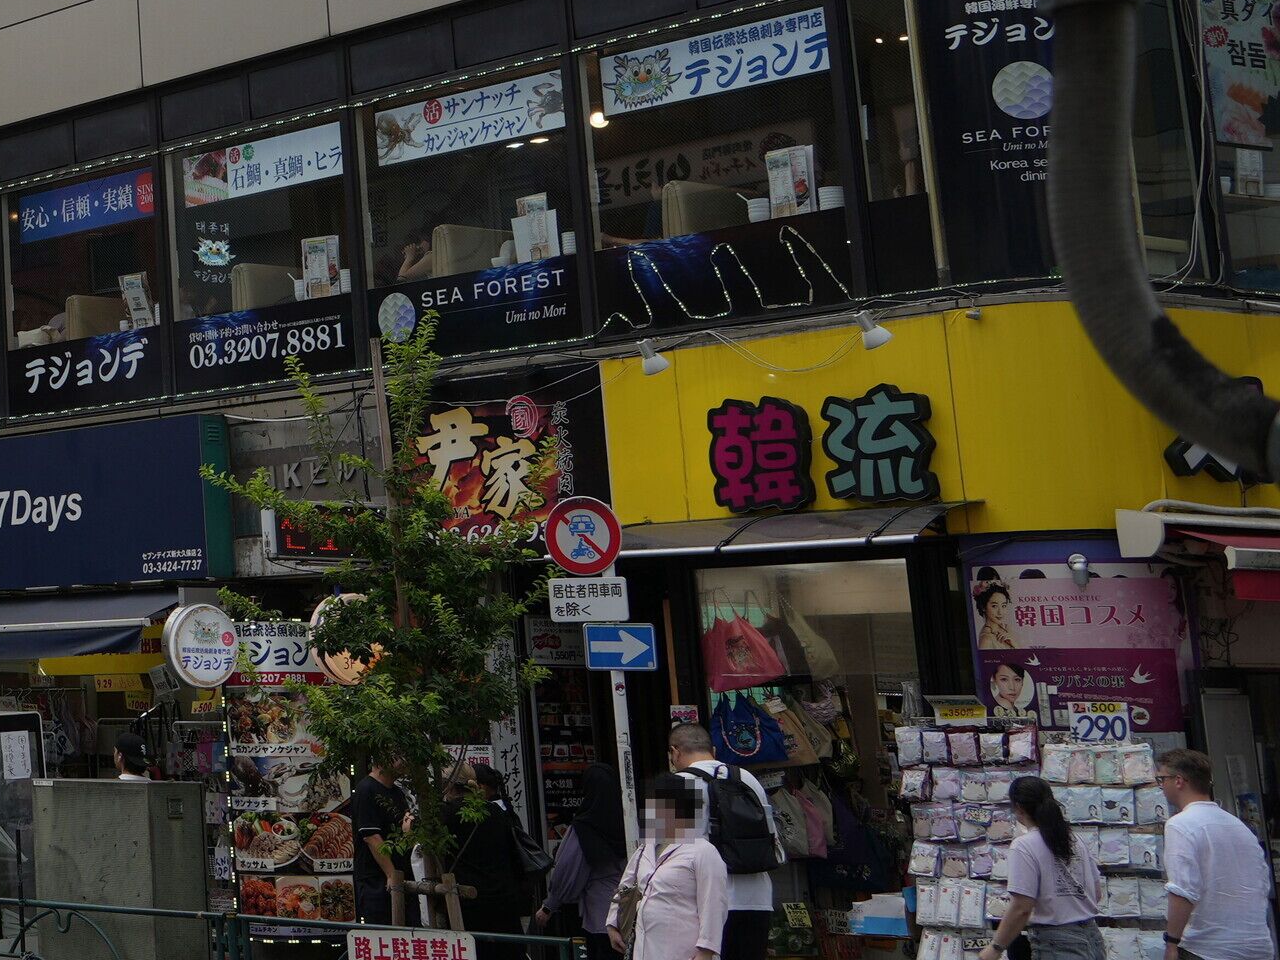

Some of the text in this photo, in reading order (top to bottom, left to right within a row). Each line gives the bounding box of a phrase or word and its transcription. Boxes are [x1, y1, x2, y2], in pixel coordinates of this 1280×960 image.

[688, 11, 824, 56] 韓国伝統活魚刺身専門店
[444, 84, 521, 119] サンナッチ
[424, 116, 528, 153] カンジャンケジャン
[962, 129, 1002, 144] SEA
[1003, 141, 1037, 152] Umi no
[990, 158, 1029, 171] Korea
[21, 183, 134, 233] 安心・信頼・実績
[421, 268, 565, 308] SEA FOREST
[505, 302, 568, 325] Umi no Mori
[189, 322, 346, 369] 03.3207.8881
[25, 337, 149, 395] テジョンデ
[709, 388, 928, 511] 韓流
[416, 406, 546, 520] 尹家
[142, 559, 202, 574] 03-3424-7737
[552, 583, 622, 599] 居住者用車両
[1051, 595, 1101, 603] COSMETIC
[554, 602, 592, 617] を除く
[1014, 603, 1146, 628] 韓国コスメ
[181, 655, 235, 671] テジョンデ
[1071, 714, 1128, 742] ¥290
[354, 936, 469, 960] 路上駐車禁止
